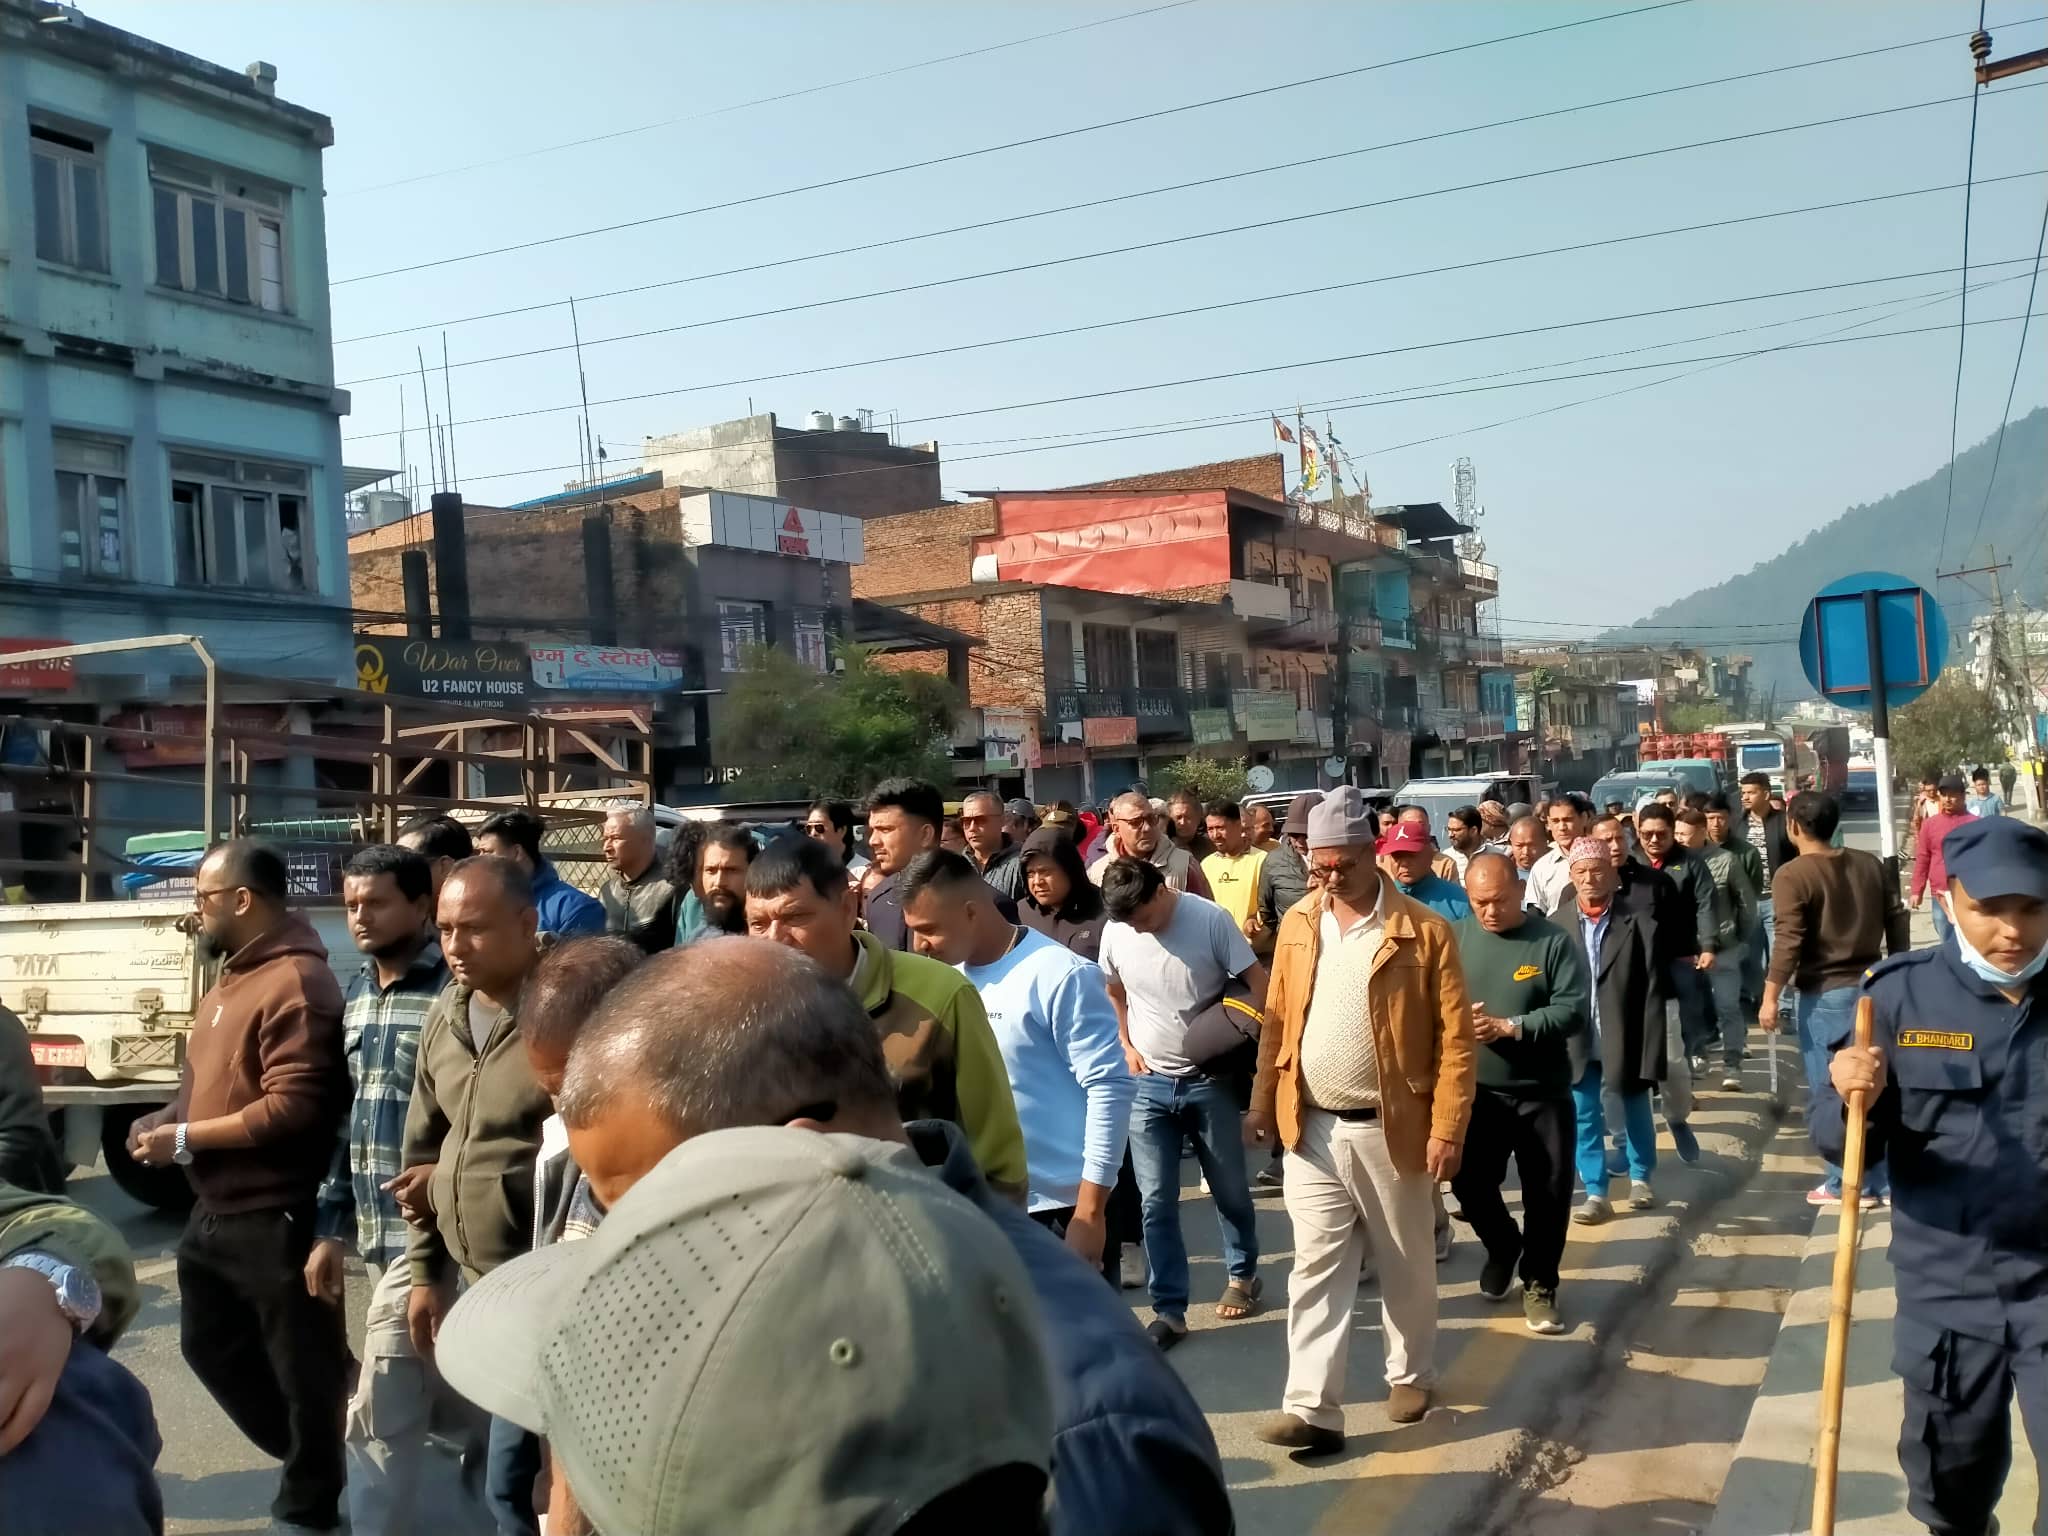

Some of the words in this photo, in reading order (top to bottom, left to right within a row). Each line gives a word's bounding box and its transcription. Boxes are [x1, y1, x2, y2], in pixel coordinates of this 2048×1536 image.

[422, 680, 440, 693] U2
[443, 680, 482, 694] FANCY
[486, 681, 524, 695] HOUSE
[13, 955, 60, 976] TATA
[1903, 1033, 1913, 1044] J.
[1916, 1033, 1966, 1047] BHANDARI
